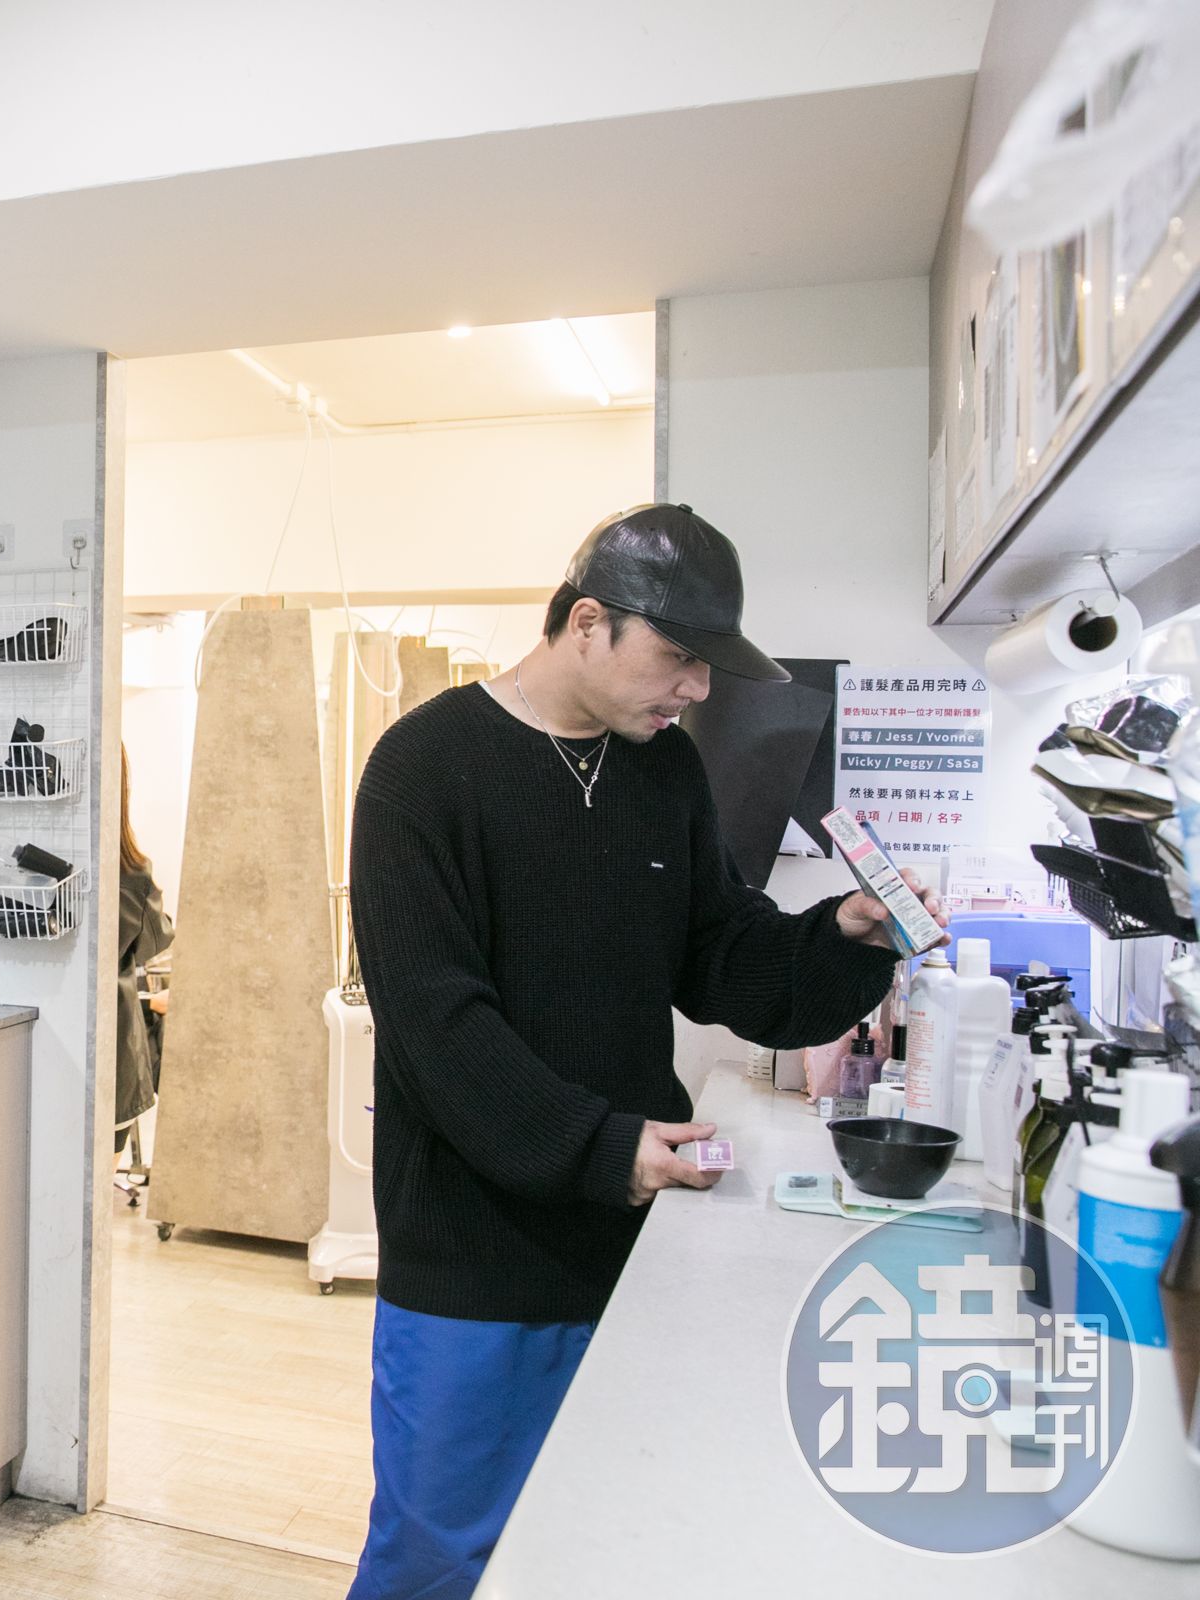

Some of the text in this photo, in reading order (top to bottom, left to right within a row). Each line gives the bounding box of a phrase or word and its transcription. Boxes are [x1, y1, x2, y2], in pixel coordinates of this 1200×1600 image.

[860, 678, 967, 692] 護髮產品用完時
[885, 732, 913, 742] Jess
[926, 732, 975, 743] Yvonne
[847, 757, 881, 769] Vicky
[895, 758, 934, 770] Peggy
[947, 759, 979, 769] SaSa
[849, 787, 974, 801] 然後要再領料本寫上
[855, 810, 880, 822] 品項
[898, 811, 923, 823] 日期
[937, 813, 963, 824] 名字
